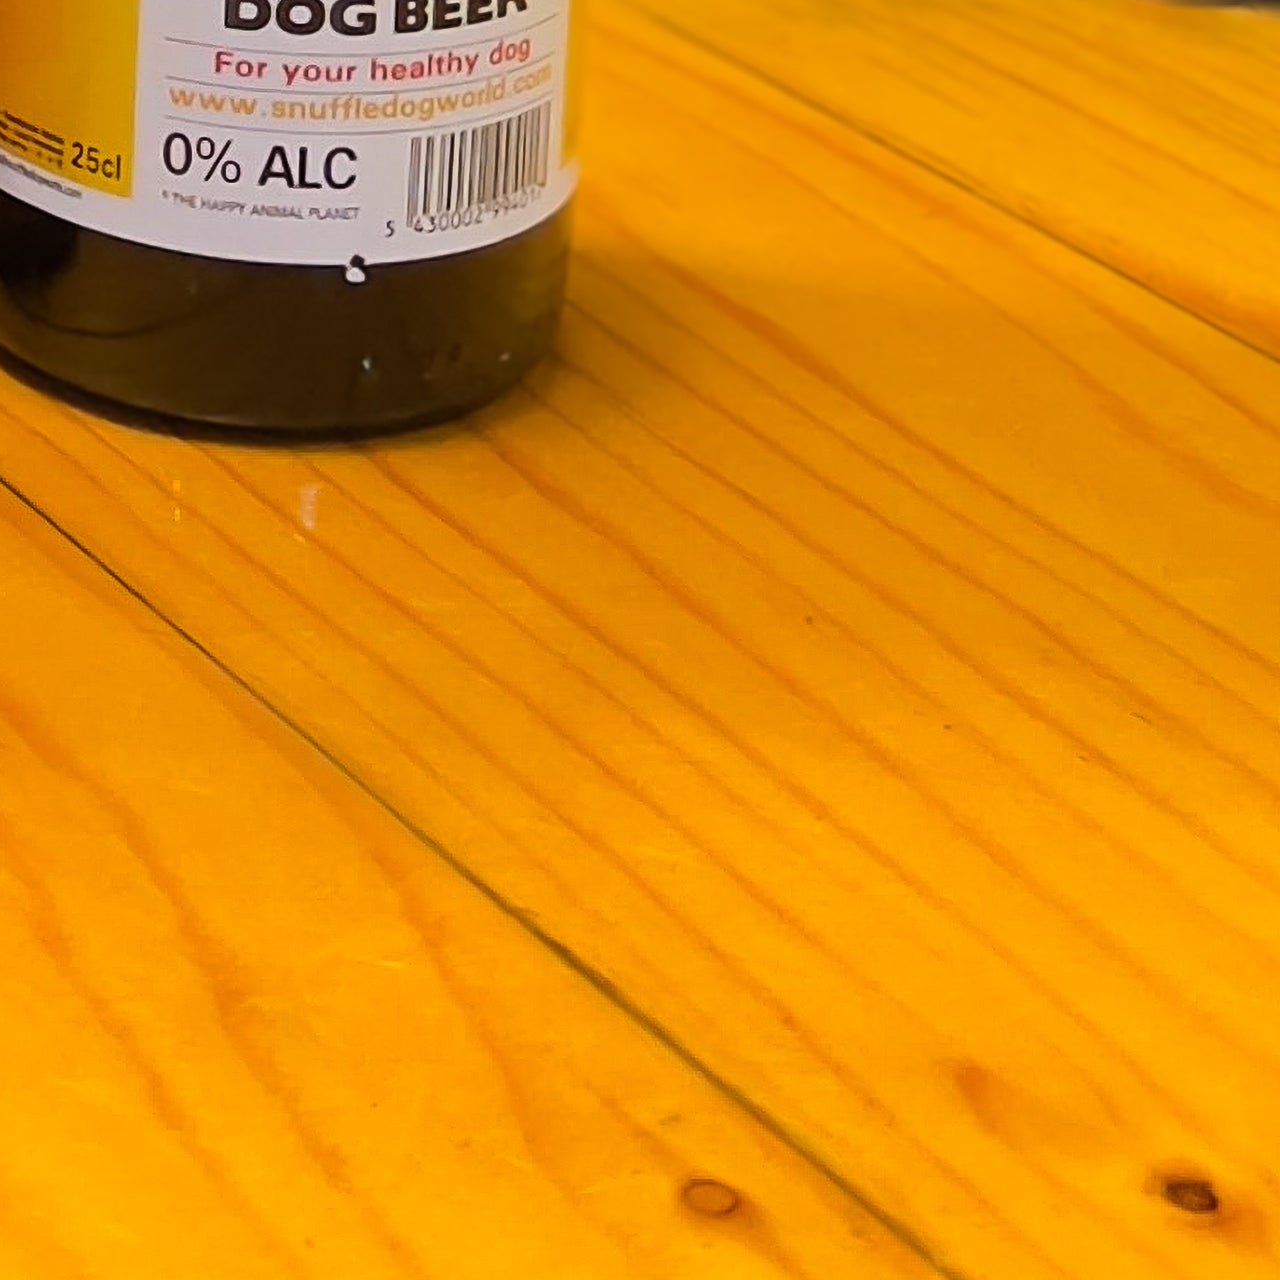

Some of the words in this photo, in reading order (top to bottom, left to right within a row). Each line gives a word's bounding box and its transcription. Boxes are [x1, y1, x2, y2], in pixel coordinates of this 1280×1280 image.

[213, 51, 268, 79] For
[283, 61, 356, 88] your
[370, 50, 478, 82] healthy
[489, 37, 532, 68] dog
[168, 65, 550, 122] www.snuffledogworld.com
[71, 142, 121, 181] 25cl
[163, 132, 241, 185] 0%
[258, 145, 357, 190] ALC
[251, 205, 304, 220] ANIMAL
[309, 207, 360, 220] PLANET
